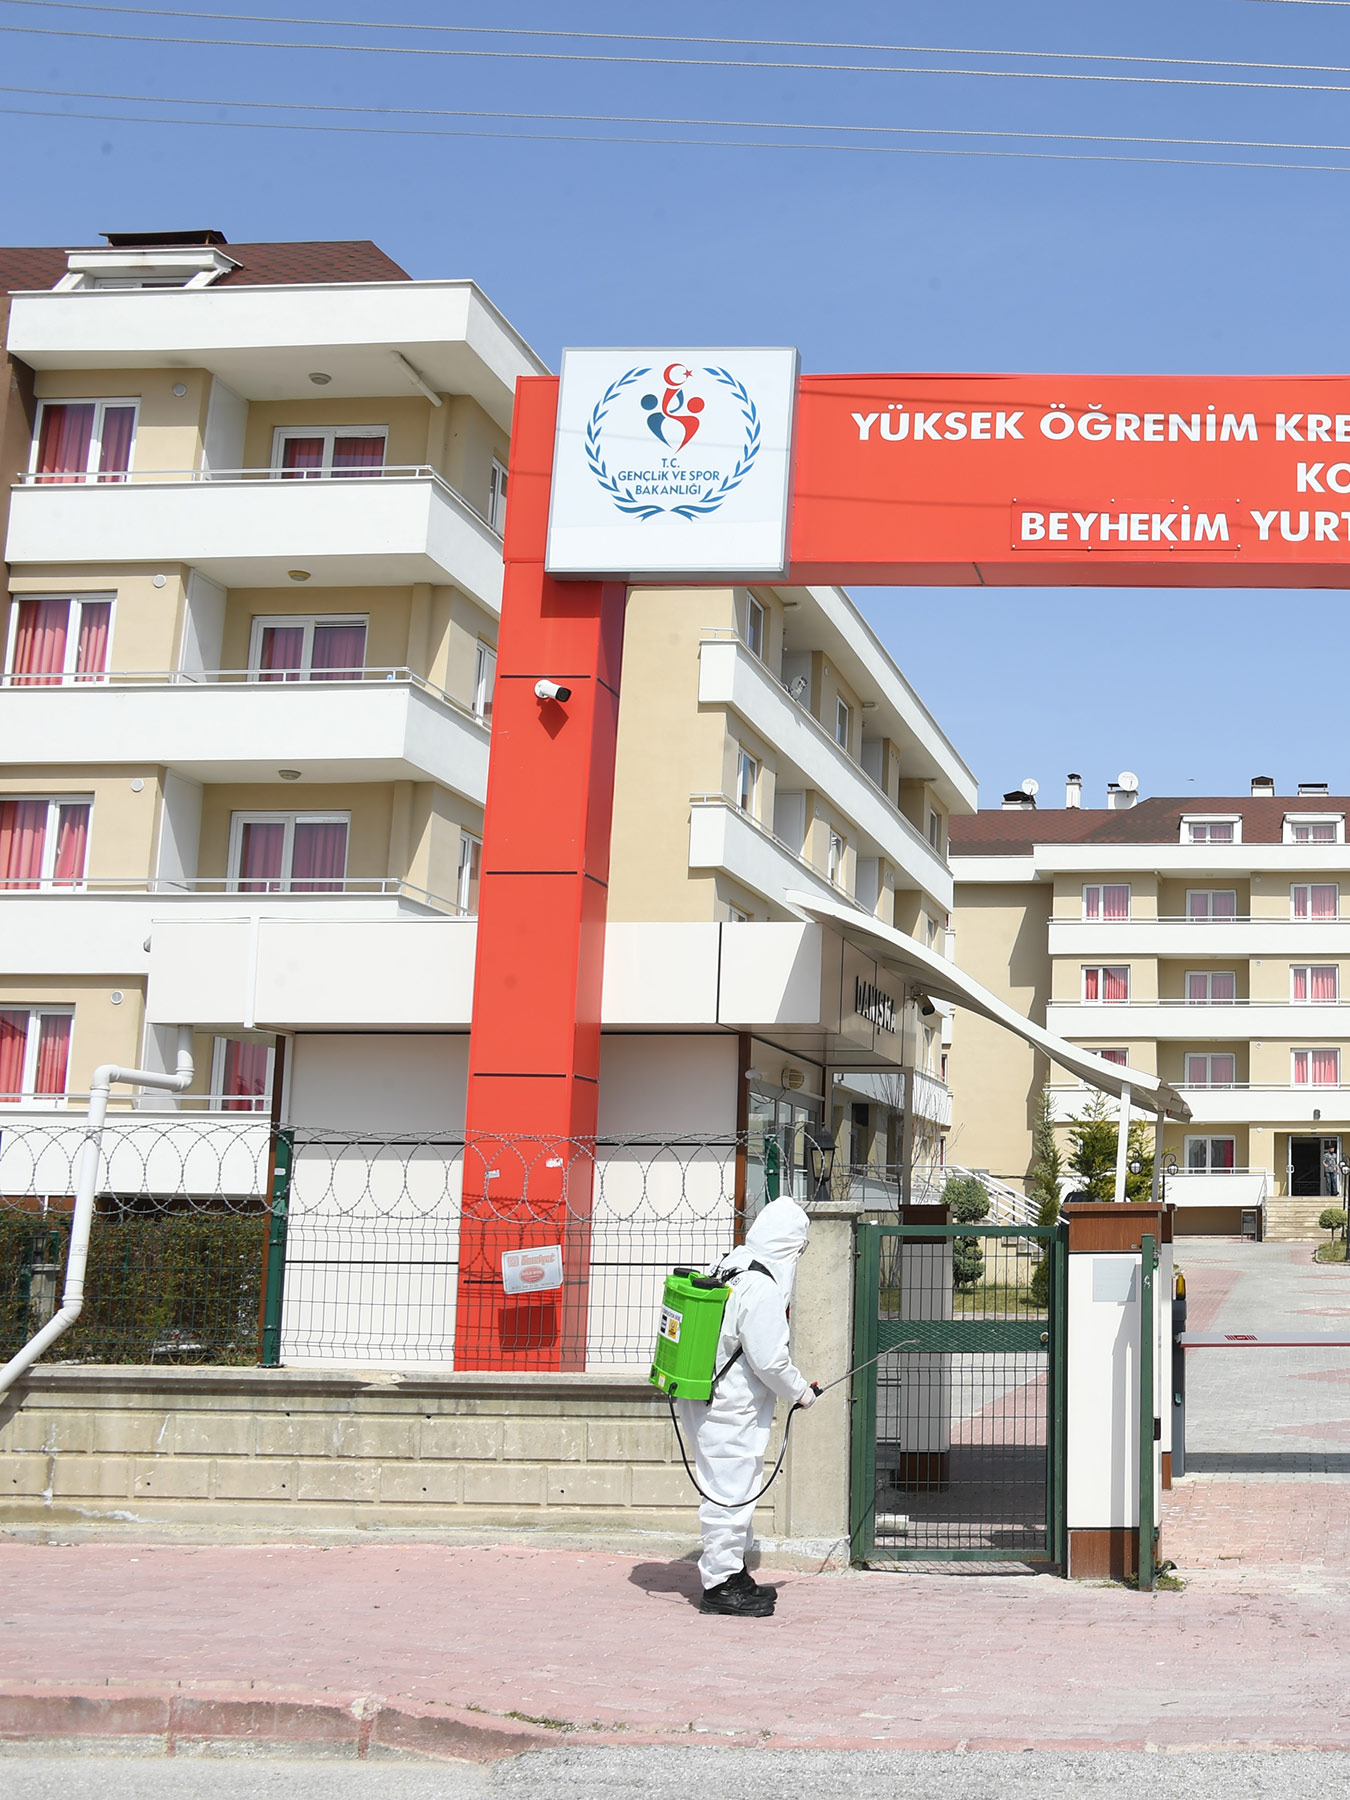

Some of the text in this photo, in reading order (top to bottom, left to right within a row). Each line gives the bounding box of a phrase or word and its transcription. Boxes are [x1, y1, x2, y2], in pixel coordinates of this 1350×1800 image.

[851, 404, 1024, 441] YÜKSEK
[1040, 403, 1258, 442] ÖĞRENİM
[661, 458, 680, 468] T.C.
[671, 470, 686, 481] VE
[689, 470, 720, 481] SPOR
[635, 483, 701, 495] BAKANLIĞI
[1021, 504, 1230, 542] BEYHEKİM
